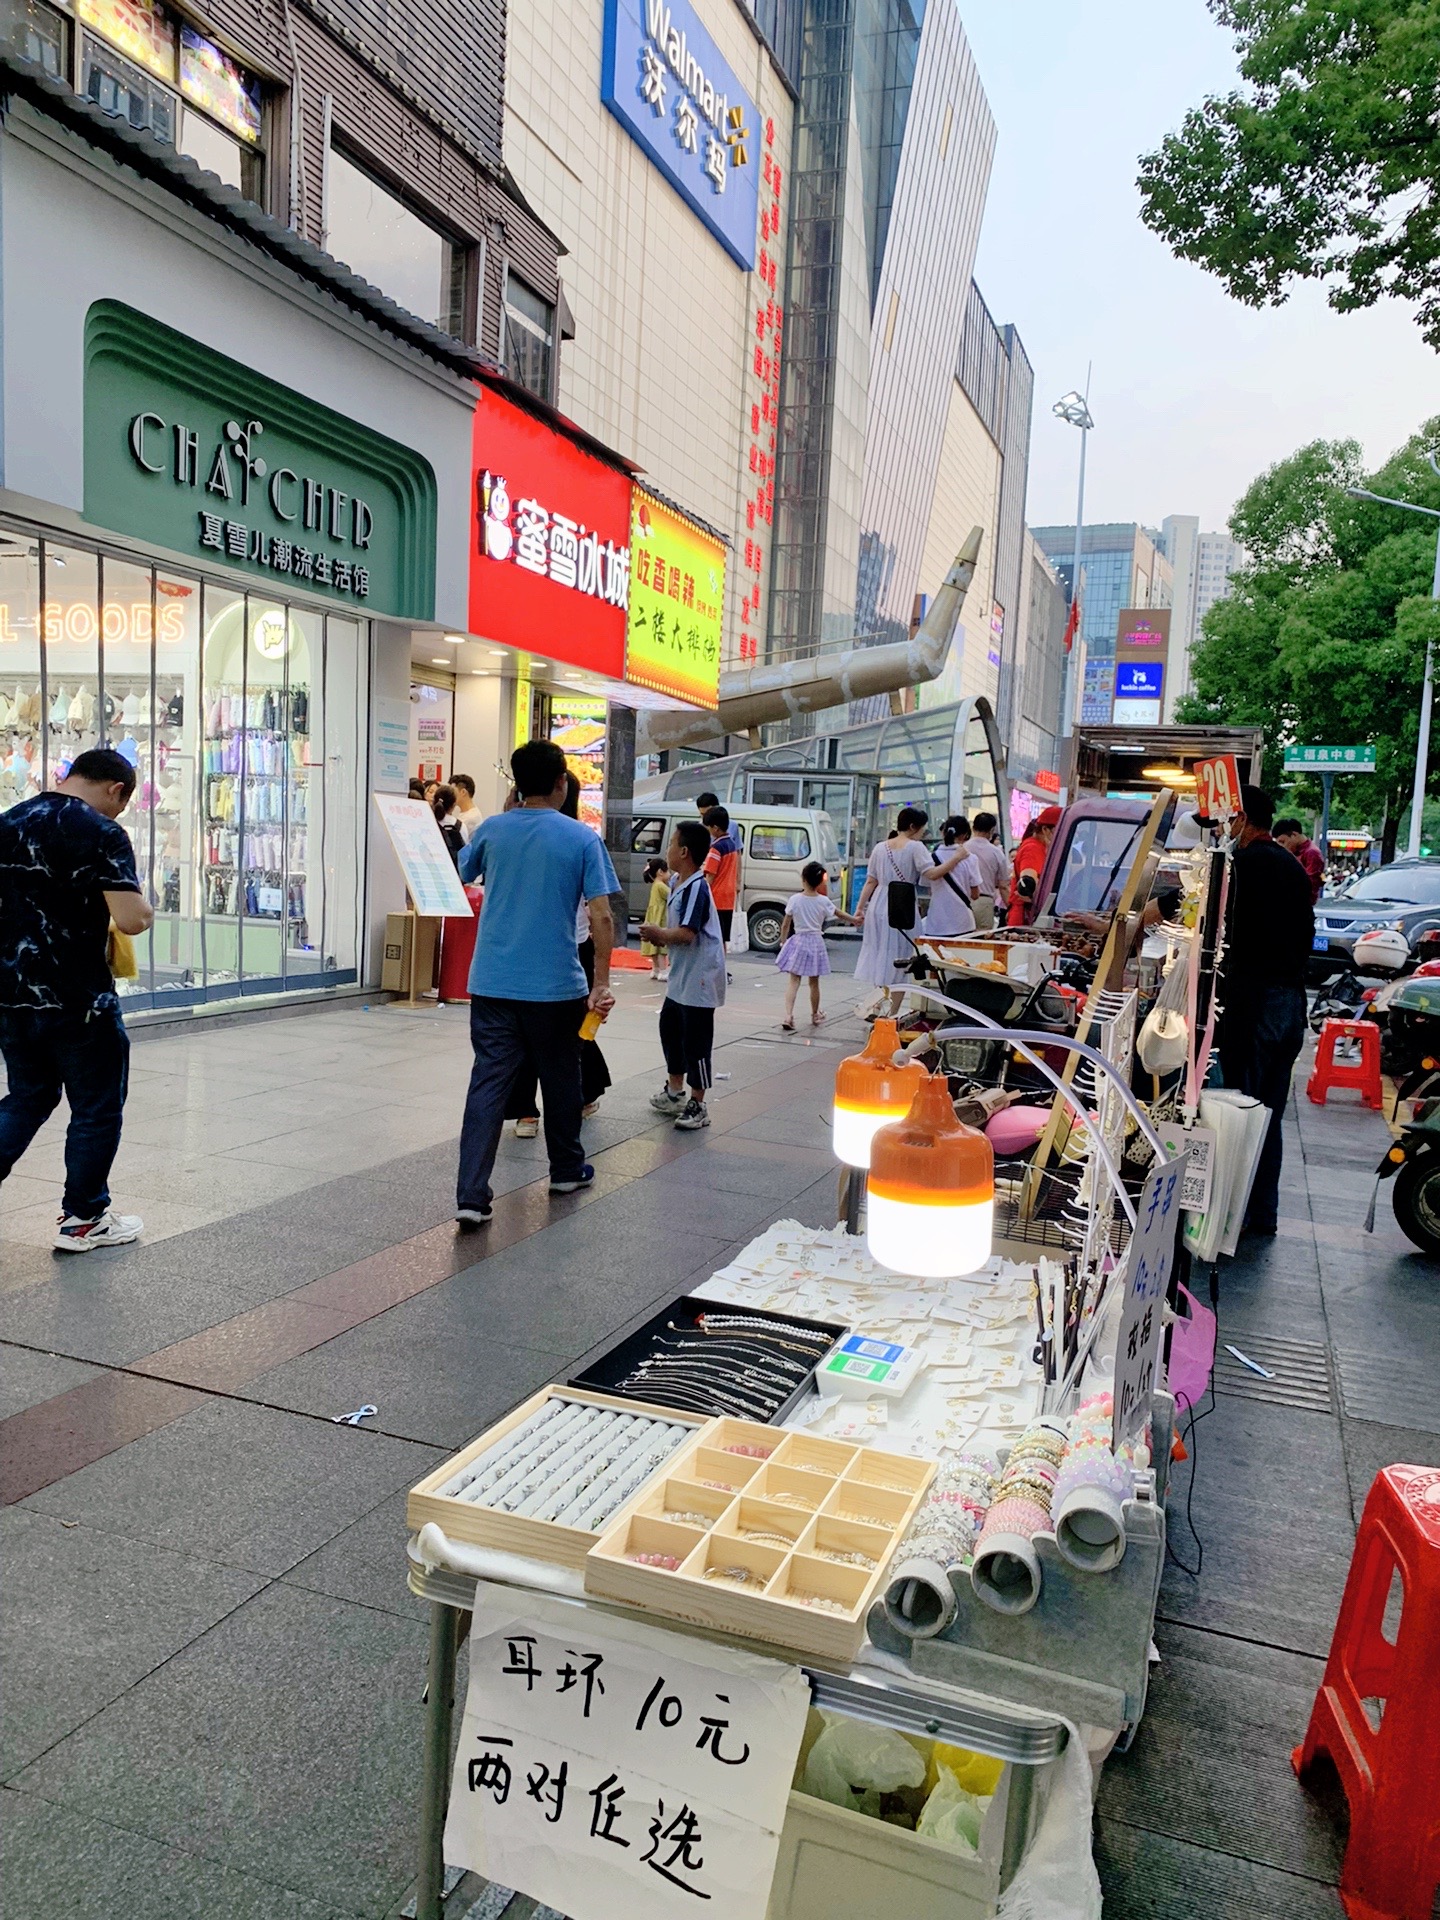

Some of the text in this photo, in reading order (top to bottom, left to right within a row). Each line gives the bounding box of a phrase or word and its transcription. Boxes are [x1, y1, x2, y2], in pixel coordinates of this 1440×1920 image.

[641, 45, 727, 194] 沃尔玛
[648, 0, 730, 140] Walmart
[199, 510, 370, 597] 夏雪儿潮流生活馆
[515, 498, 629, 611] 蜜雪冰城
[637, 548, 695, 609] 吃香喝辣
[35, 603, 186, 643] GOODS
[1304, 749, 1356, 761] 福泉中巷
[502, 1635, 750, 1765] 耳环 10元
[468, 1735, 712, 1899] 两对任选
